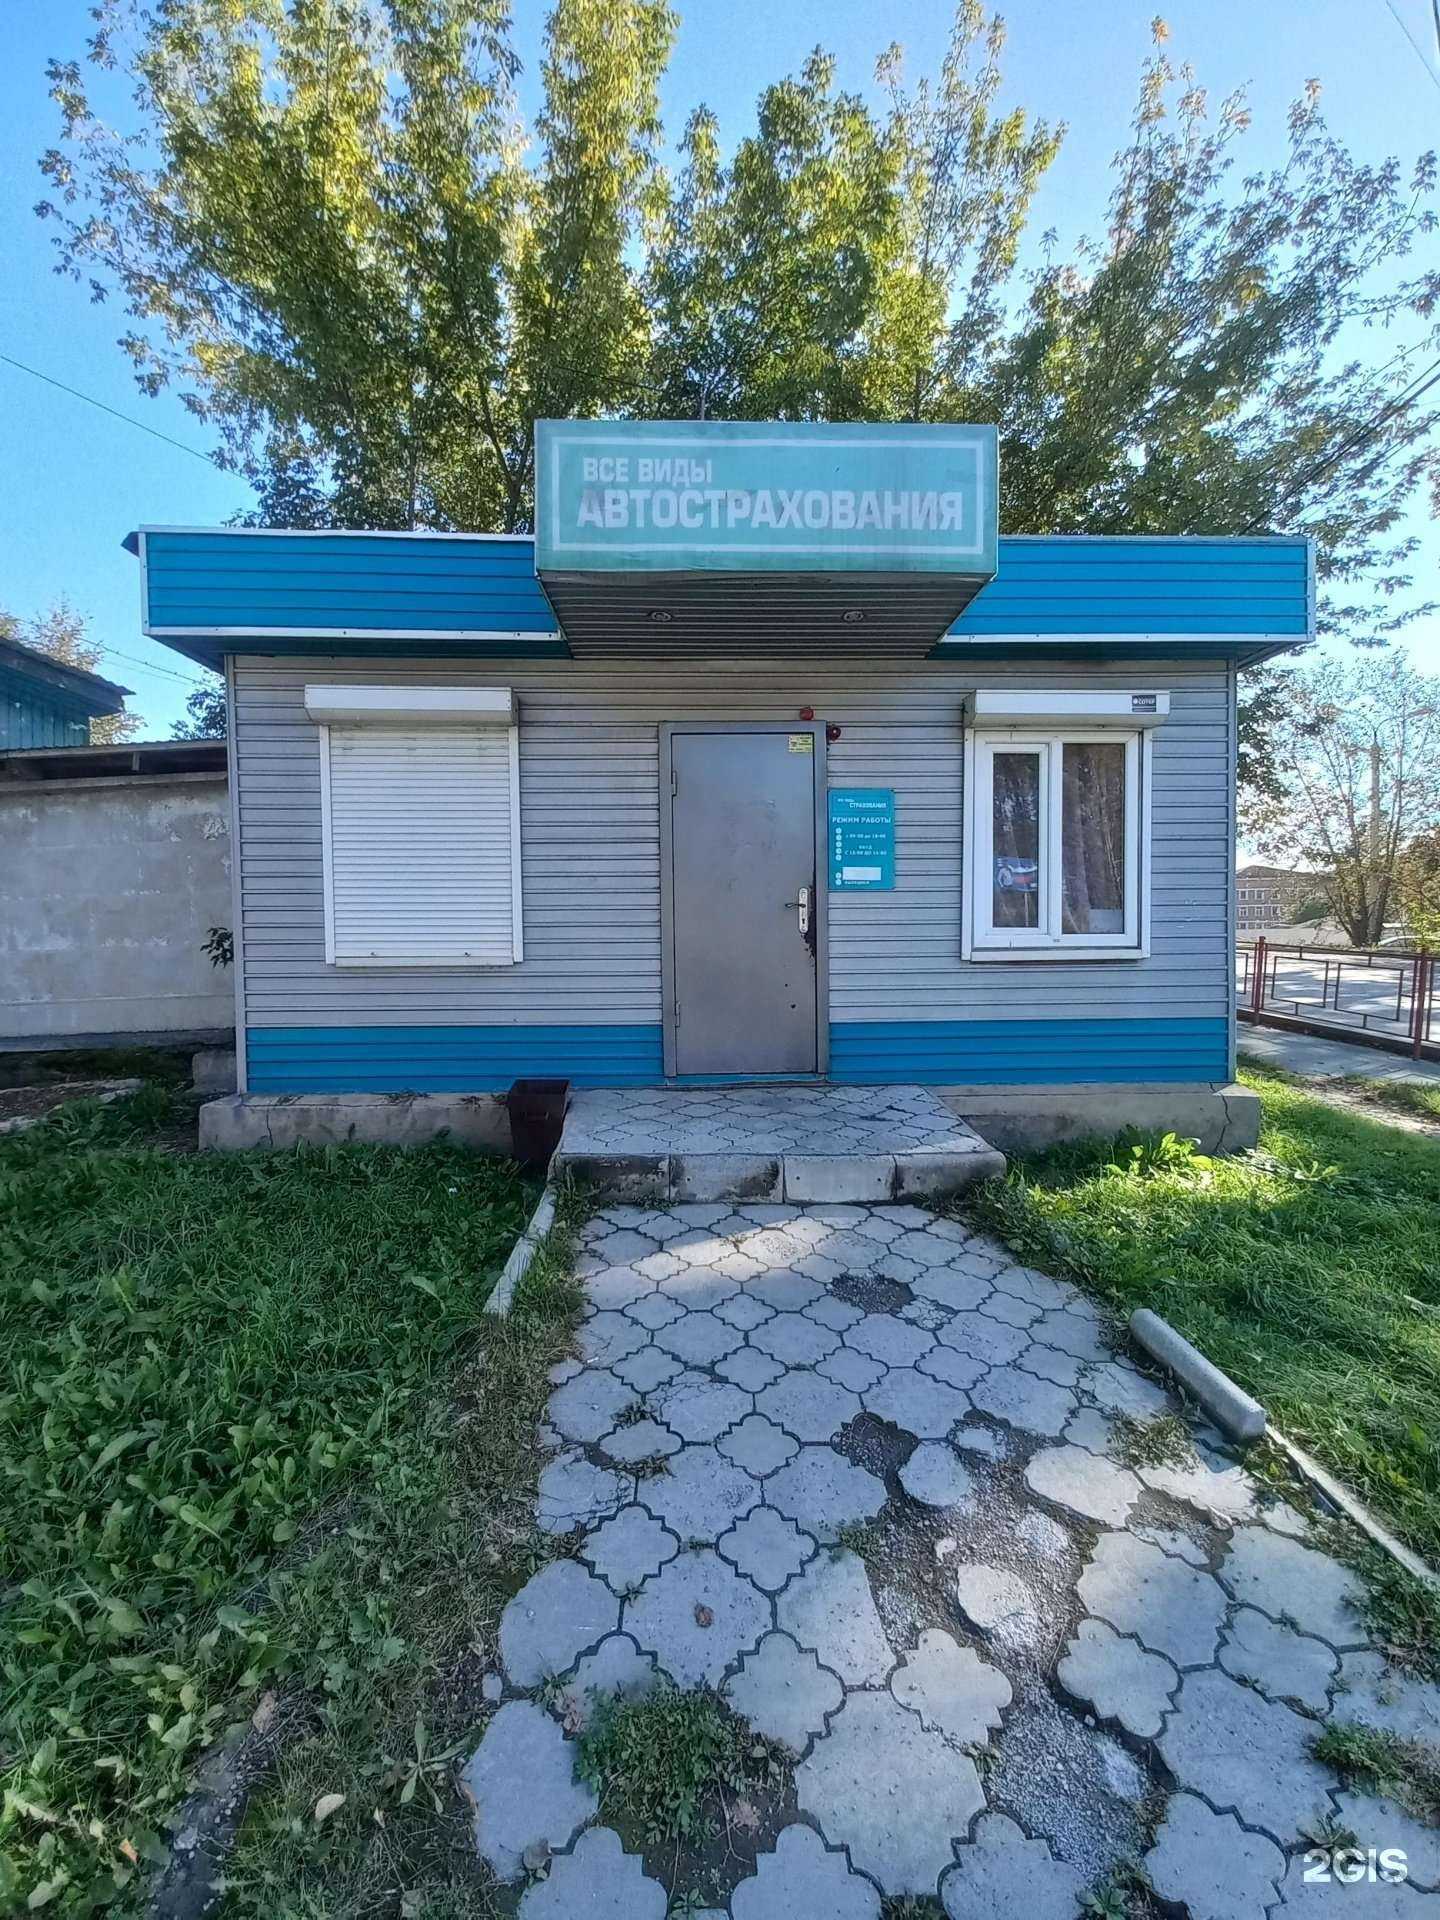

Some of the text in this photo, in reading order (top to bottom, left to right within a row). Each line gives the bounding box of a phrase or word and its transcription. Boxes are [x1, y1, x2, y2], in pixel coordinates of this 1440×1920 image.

[583, 457, 713, 488] ВСЕ ВИДЫ
[576, 488, 963, 531] АВТОСТРАХОВАНИЯ
